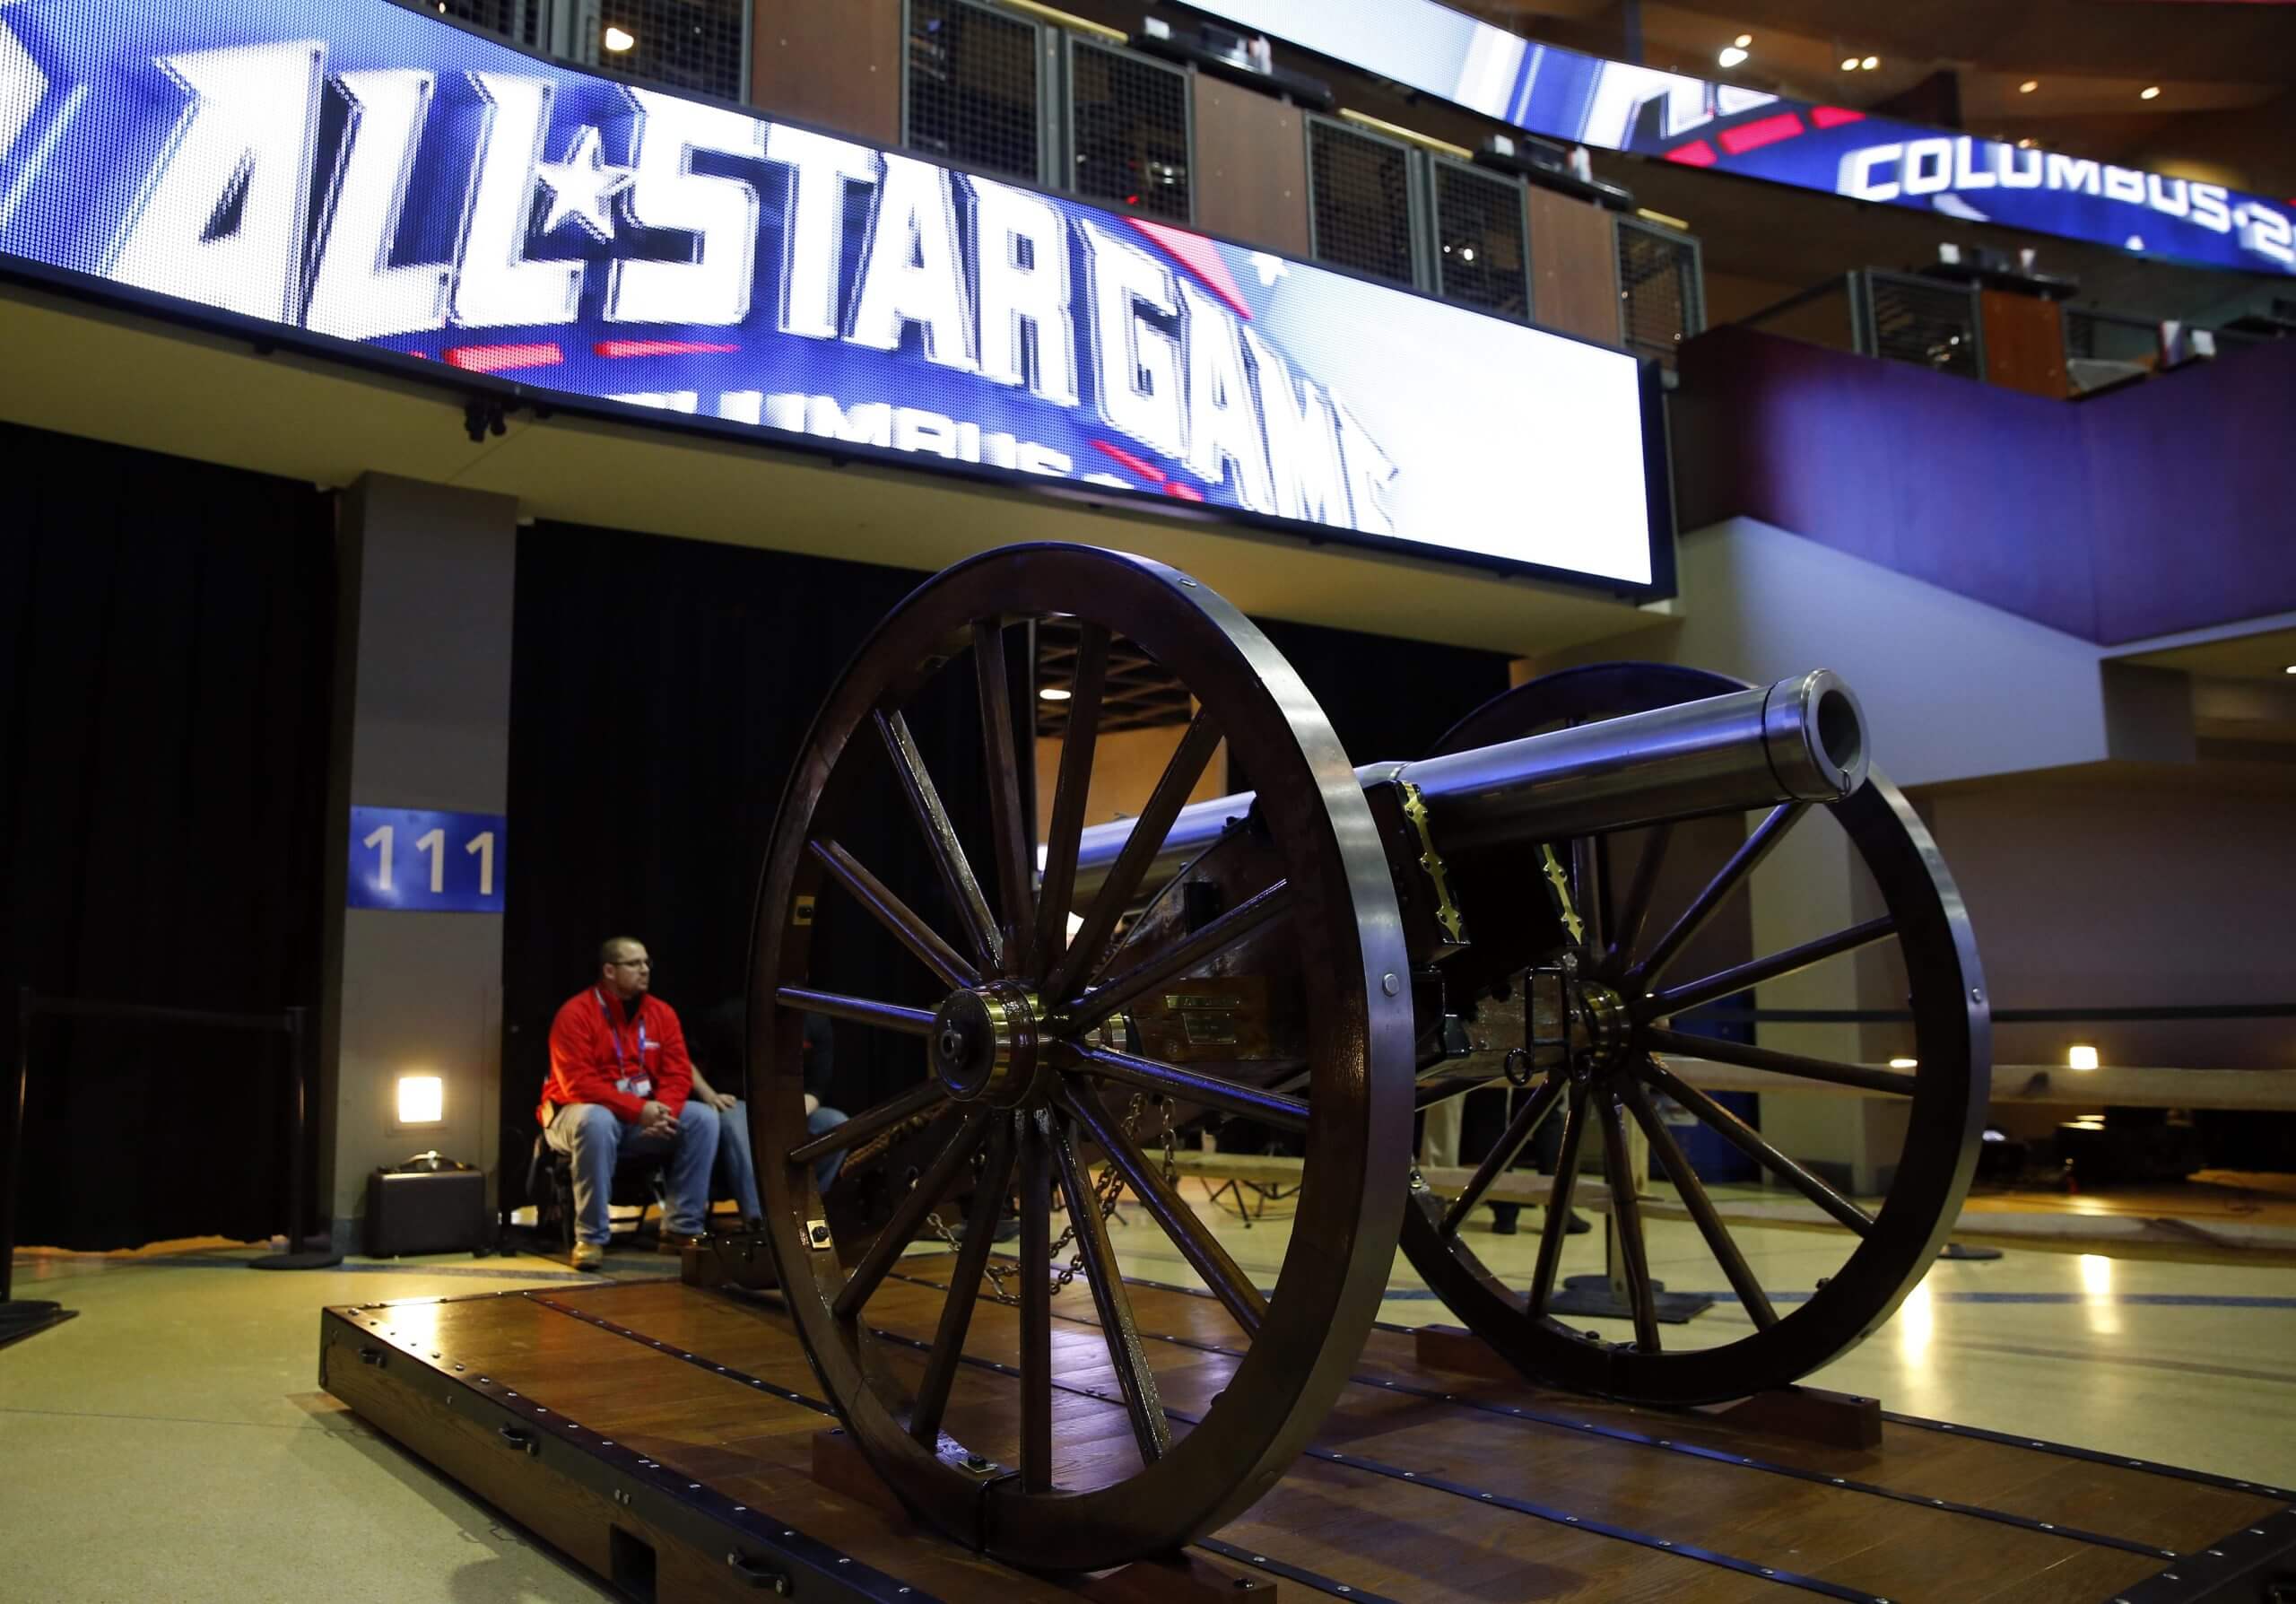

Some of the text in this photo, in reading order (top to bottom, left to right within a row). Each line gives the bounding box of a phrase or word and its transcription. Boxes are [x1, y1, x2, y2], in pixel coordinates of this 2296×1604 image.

[100, 39, 1401, 536] ALL STAR GAME
[363, 824, 494, 895] 111
